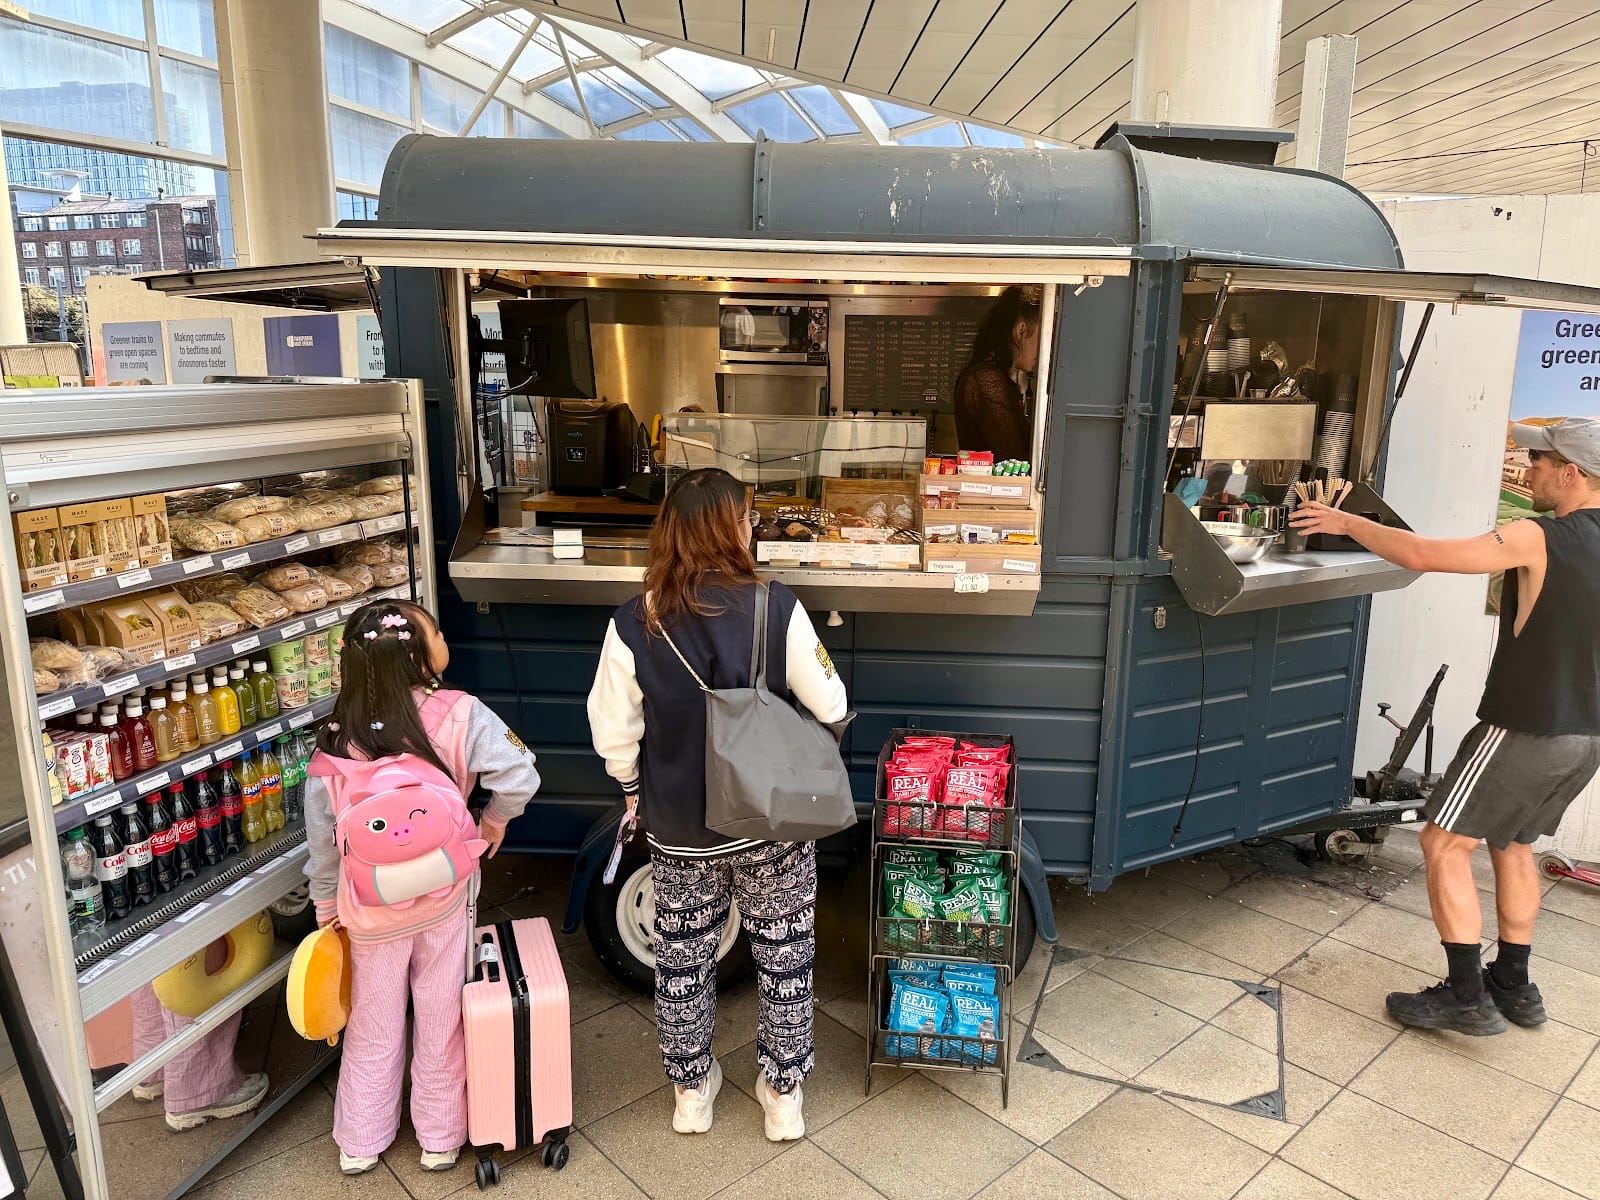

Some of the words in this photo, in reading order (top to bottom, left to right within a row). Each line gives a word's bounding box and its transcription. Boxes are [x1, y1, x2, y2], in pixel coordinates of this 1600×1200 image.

[110, 335, 131, 345] Greener
[132, 334, 147, 344] trains
[147, 335, 154, 344] to
[174, 332, 194, 344] Making
[195, 331, 226, 343] commutes
[109, 349, 124, 359] green
[125, 348, 138, 358] open
[138, 347, 158, 358] spaces
[179, 346, 186, 355] to
[186, 345, 209, 355] bedtime
[210, 345, 222, 355] and
[120, 362, 129, 370] are
[129, 360, 149, 371] coming
[209, 358, 226, 368] faster
[1541, 349, 1600, 369] green
[894, 777, 929, 790] REAL
[949, 775, 985, 790] REAL
[907, 884, 934, 904] REAL
[943, 889, 976, 910] REAL
[903, 992, 935, 1011] REAL
[956, 997, 991, 1011] REAL
